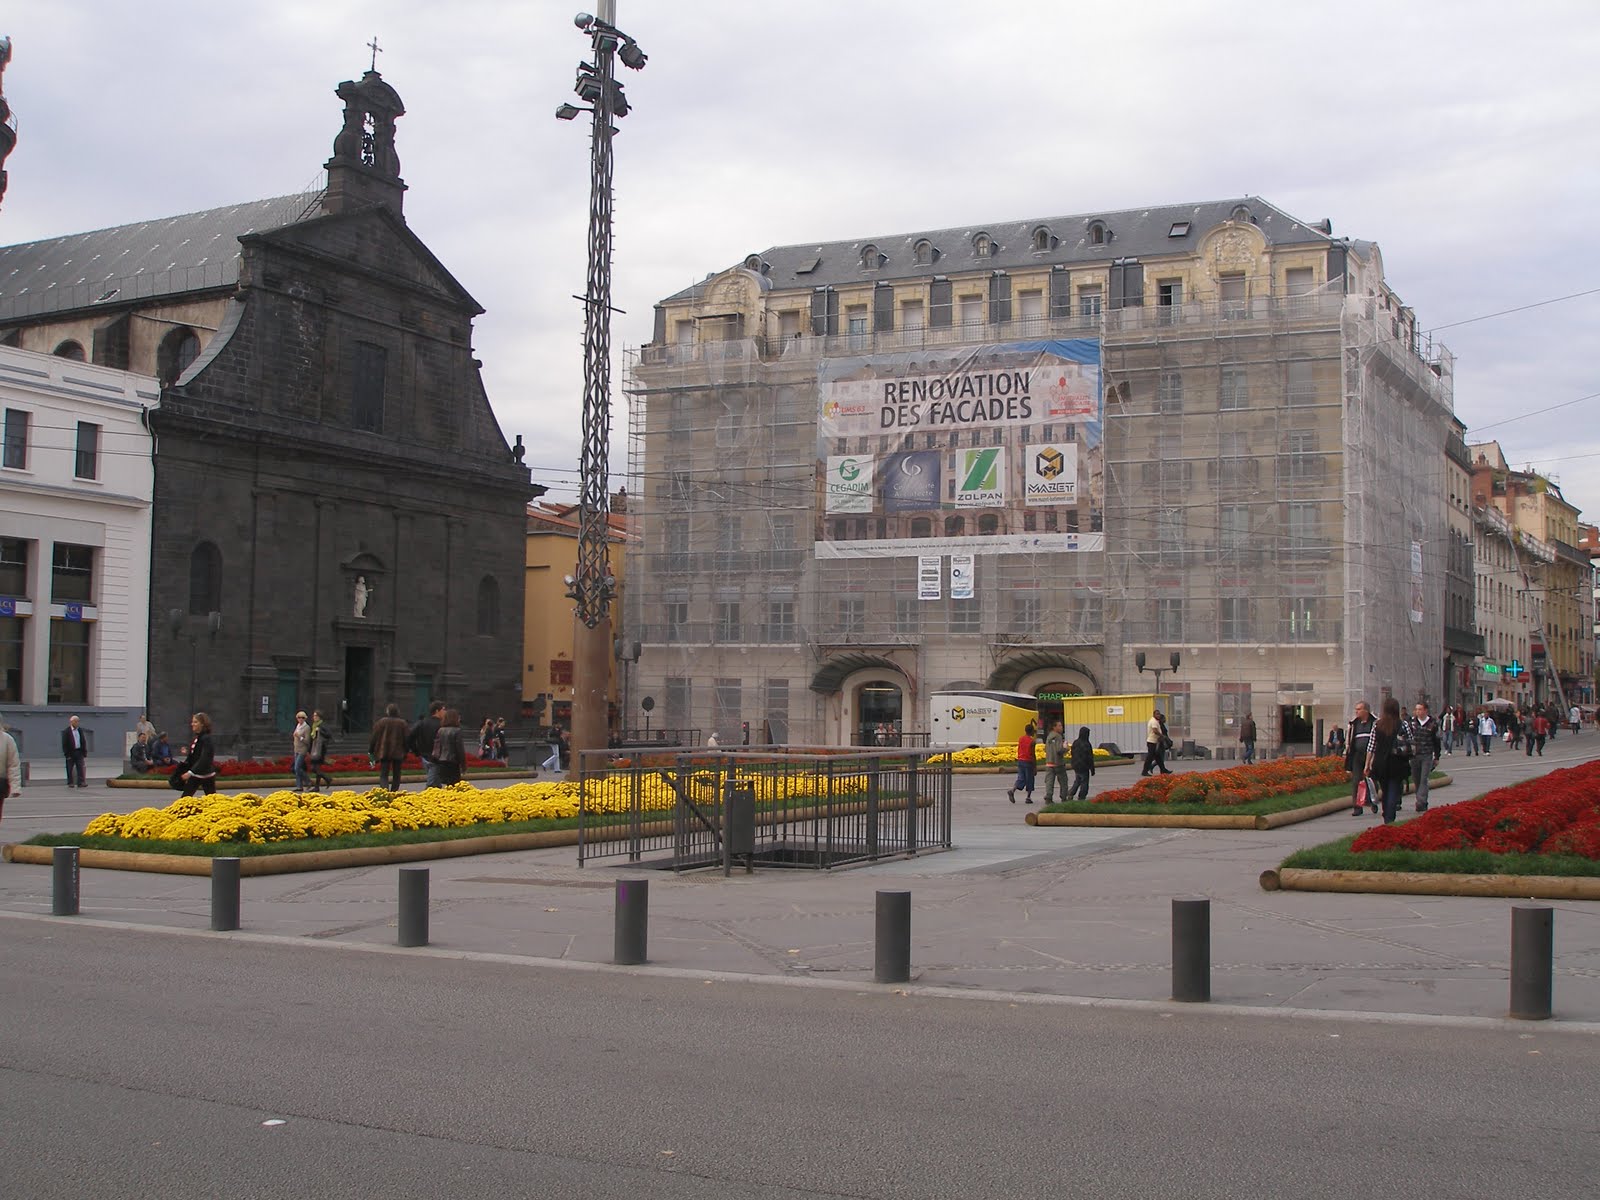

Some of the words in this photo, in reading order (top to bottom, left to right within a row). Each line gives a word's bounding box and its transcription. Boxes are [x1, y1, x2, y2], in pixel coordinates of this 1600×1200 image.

[884, 372, 1029, 404] RENOVATION
[881, 404, 921, 428] DES
[930, 396, 1032, 424] FACADES
[830, 482, 869, 493] CEGADIM
[1028, 482, 1075, 494] MAZET
[957, 492, 1002, 501] ZOLPAN
